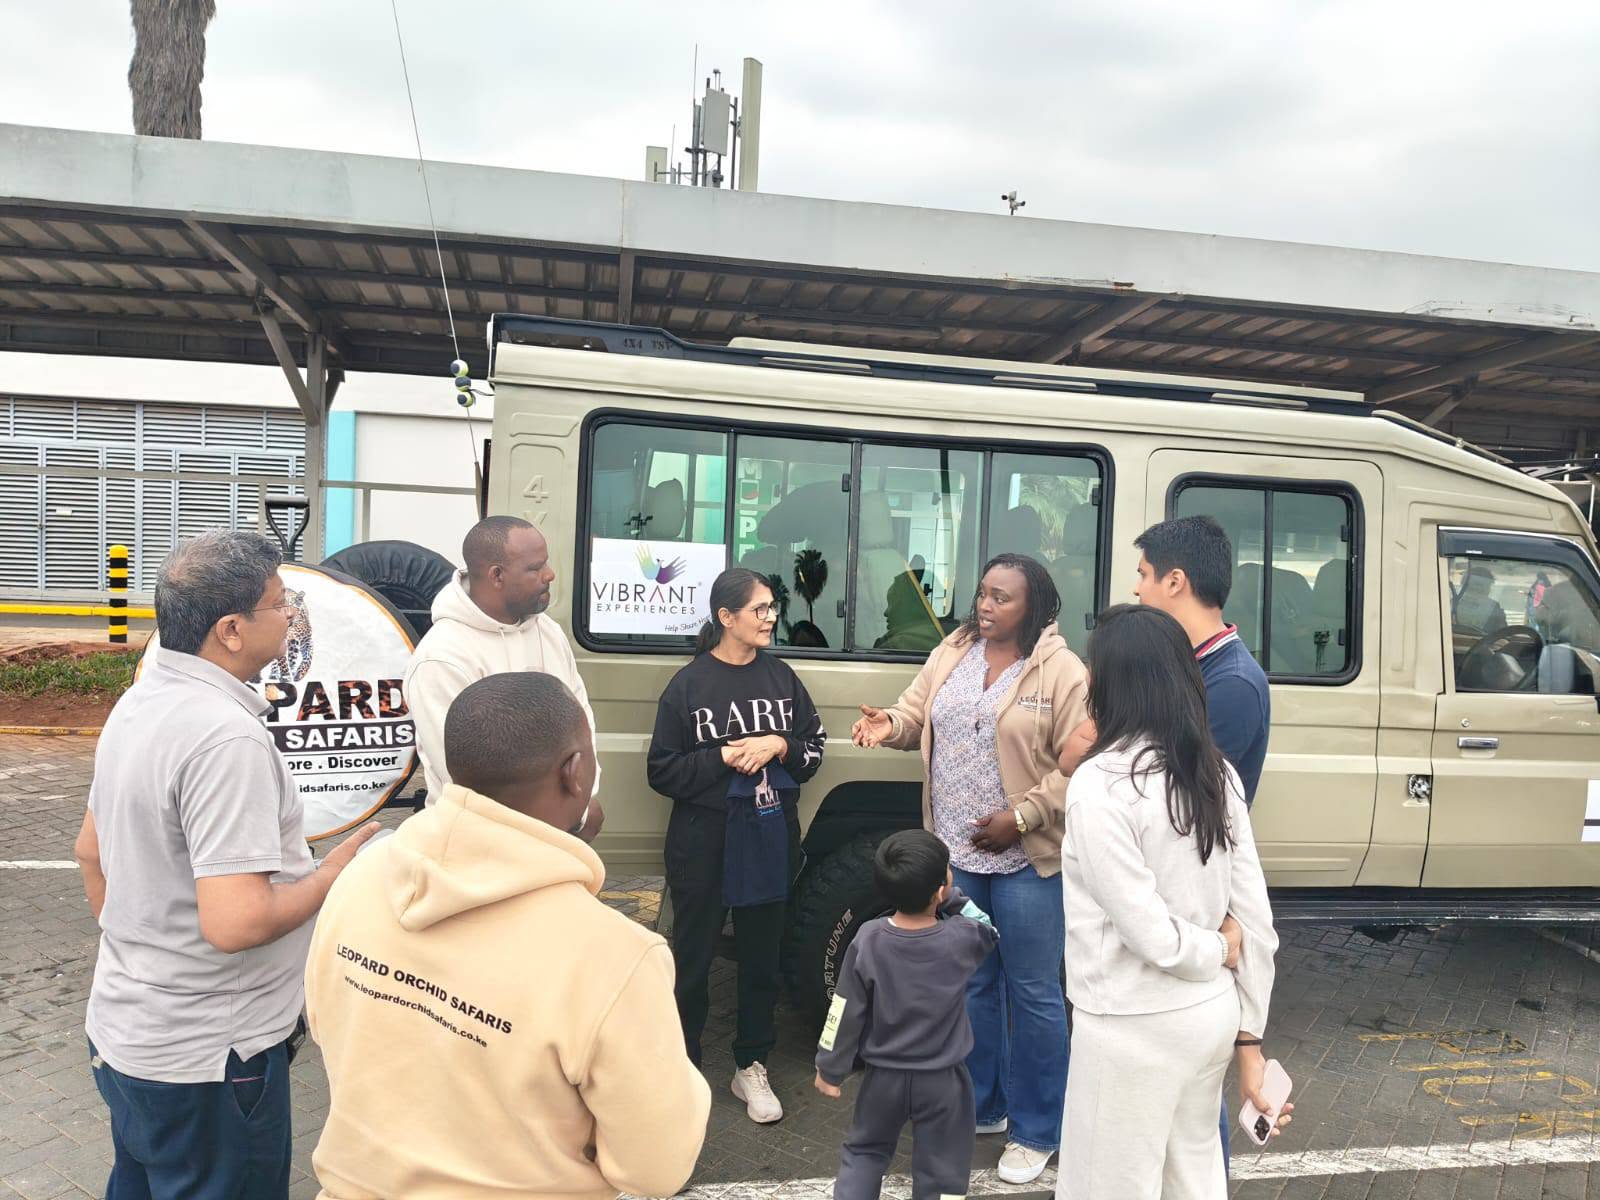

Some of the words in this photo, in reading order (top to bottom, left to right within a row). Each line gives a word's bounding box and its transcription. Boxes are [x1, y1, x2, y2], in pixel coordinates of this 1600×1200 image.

[592, 581, 697, 604] VIBRANT
[596, 602, 696, 615] EXPERIENCES
[664, 623, 679, 633] Help
[680, 621, 698, 631] Share
[248, 678, 409, 722] PARD
[285, 724, 414, 749] SAFARIS
[327, 755, 399, 770] Discover
[299, 780, 387, 794] idsafaris.co.ke
[823, 908, 854, 1001] ORTUNE
[336, 943, 390, 977] LEOPARD
[393, 969, 448, 1003] ORCHID
[449, 995, 513, 1035] SAFARIS
[344, 974, 488, 1049] www.leopardorchidsafaris.co.ke
